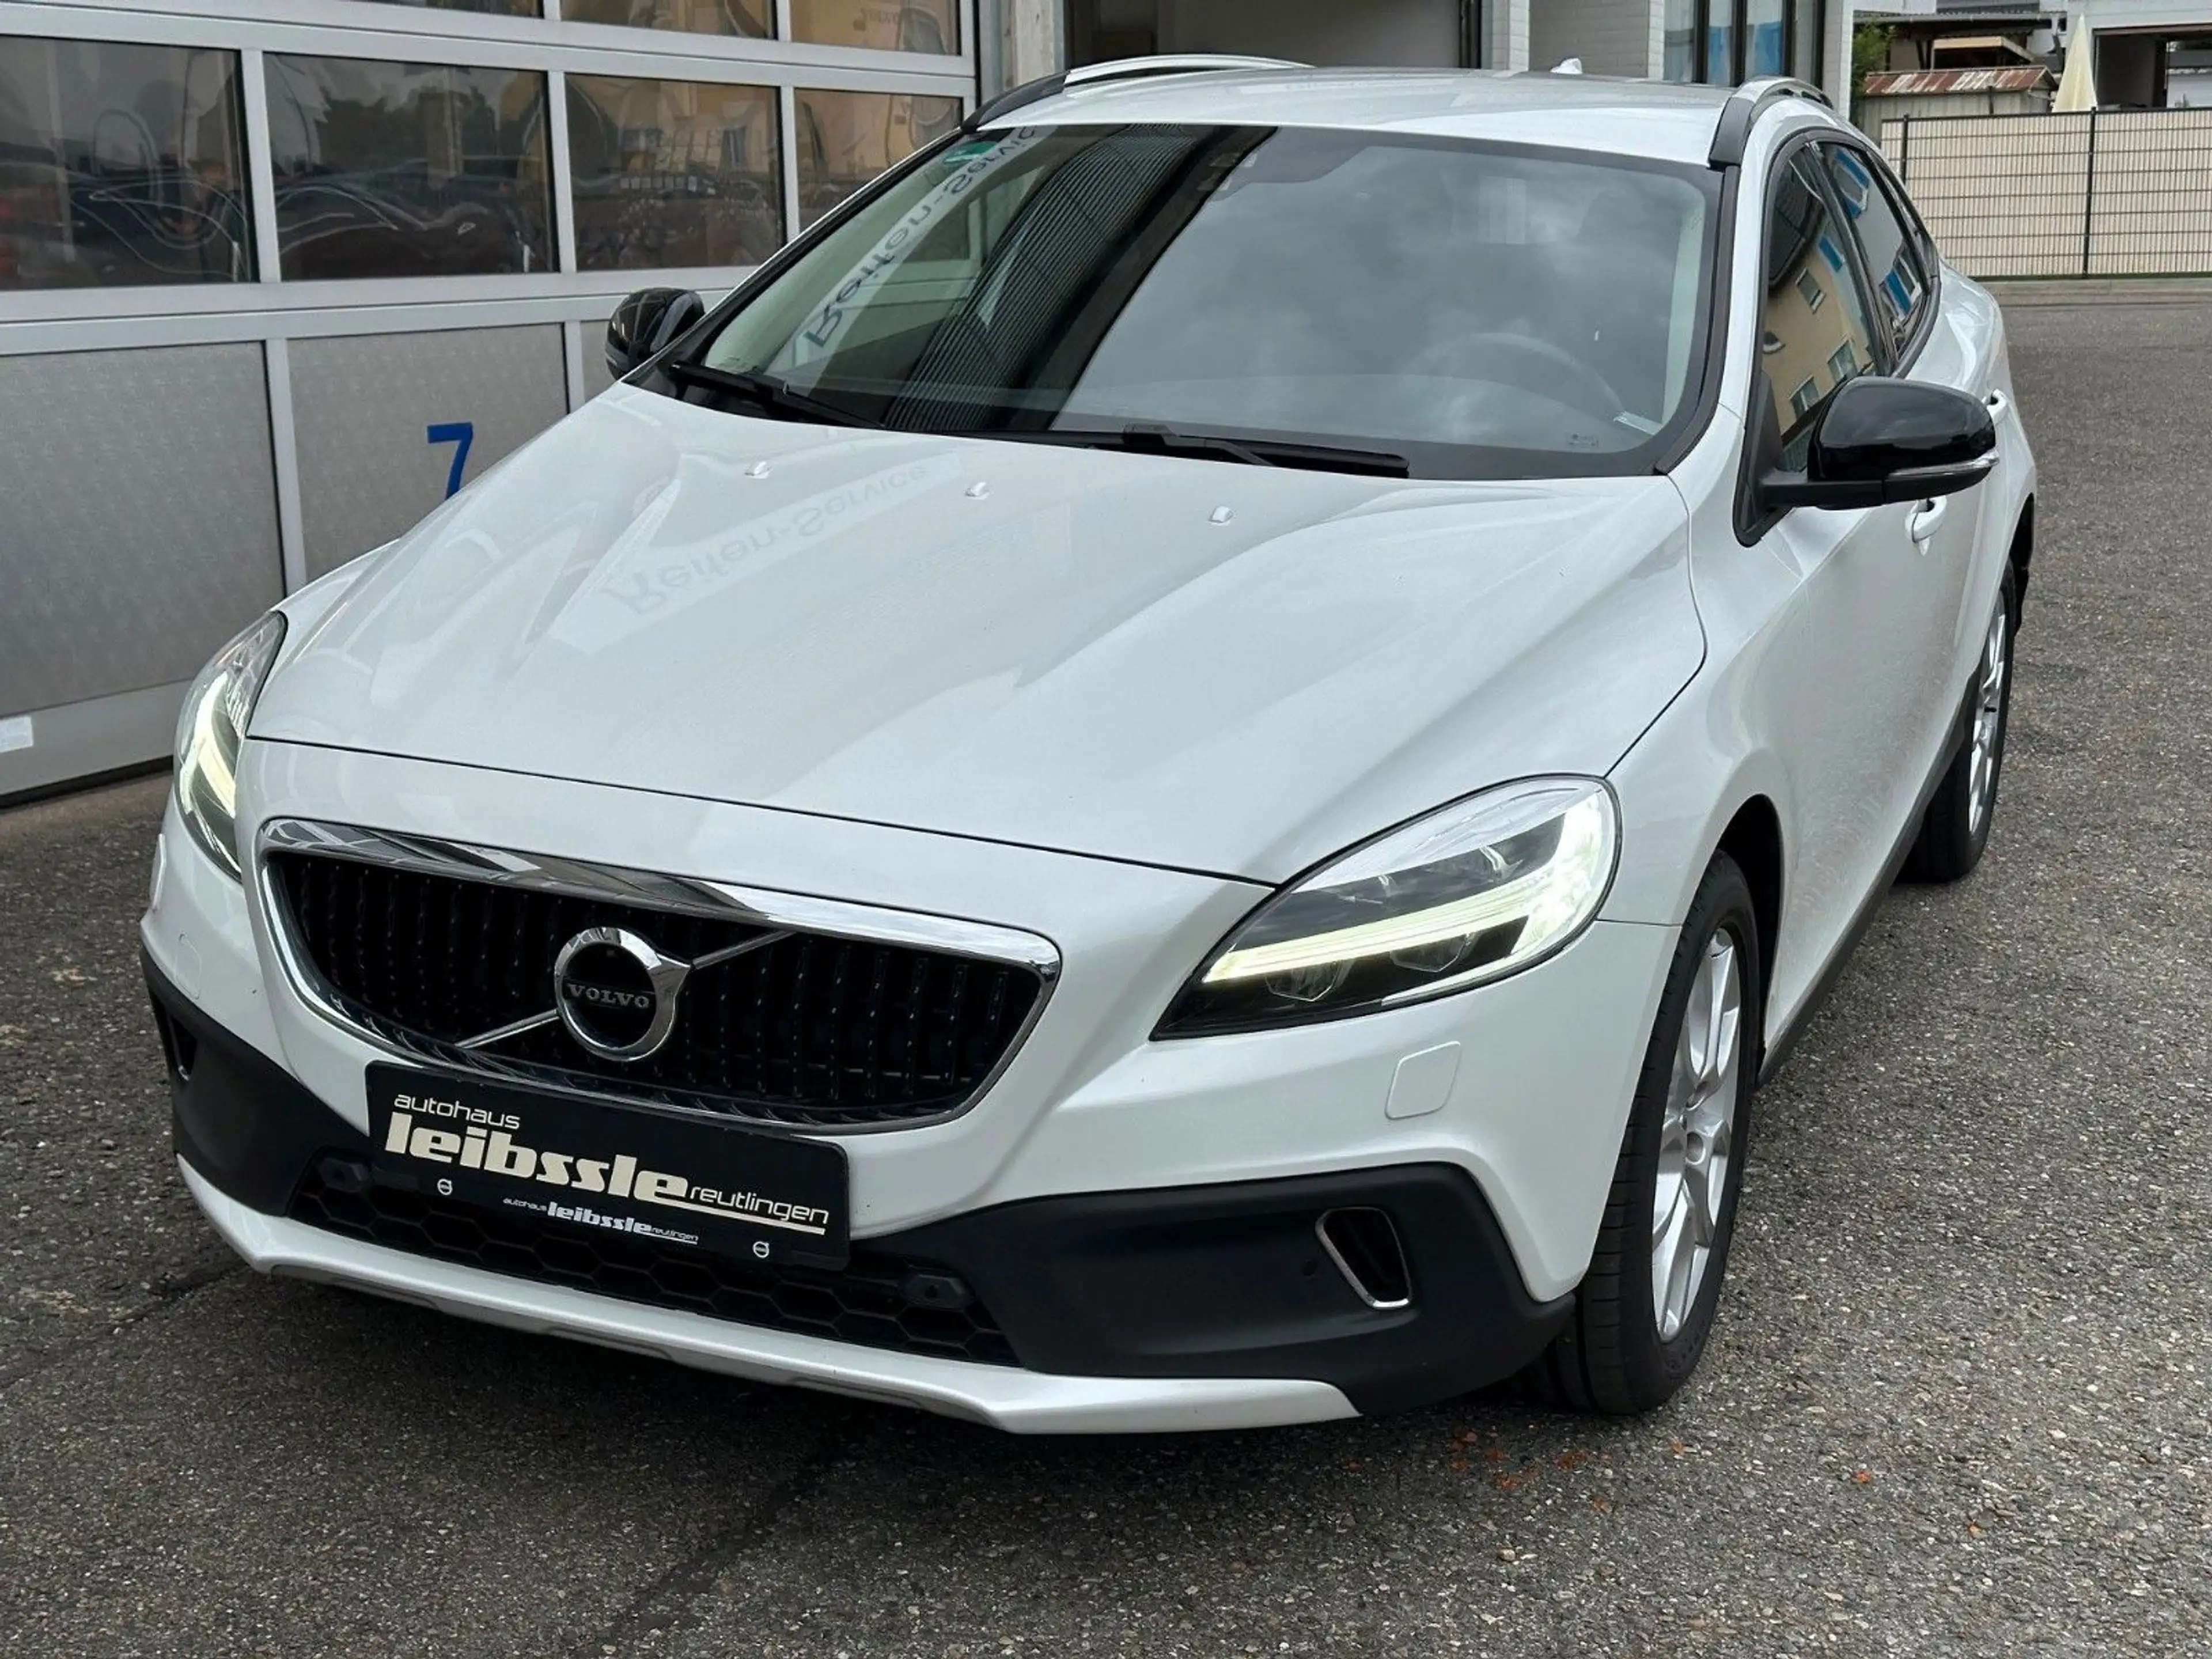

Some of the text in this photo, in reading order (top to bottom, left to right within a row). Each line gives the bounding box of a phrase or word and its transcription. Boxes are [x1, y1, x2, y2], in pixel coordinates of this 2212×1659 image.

[426, 422, 473, 501] 7
[567, 983, 650, 1008] VOLVO
[393, 1094, 521, 1130] autohaus
[385, 1111, 829, 1225] leibssle reutlingen
[503, 1197, 547, 1211] autohaus
[547, 1201, 652, 1233] leibssle
